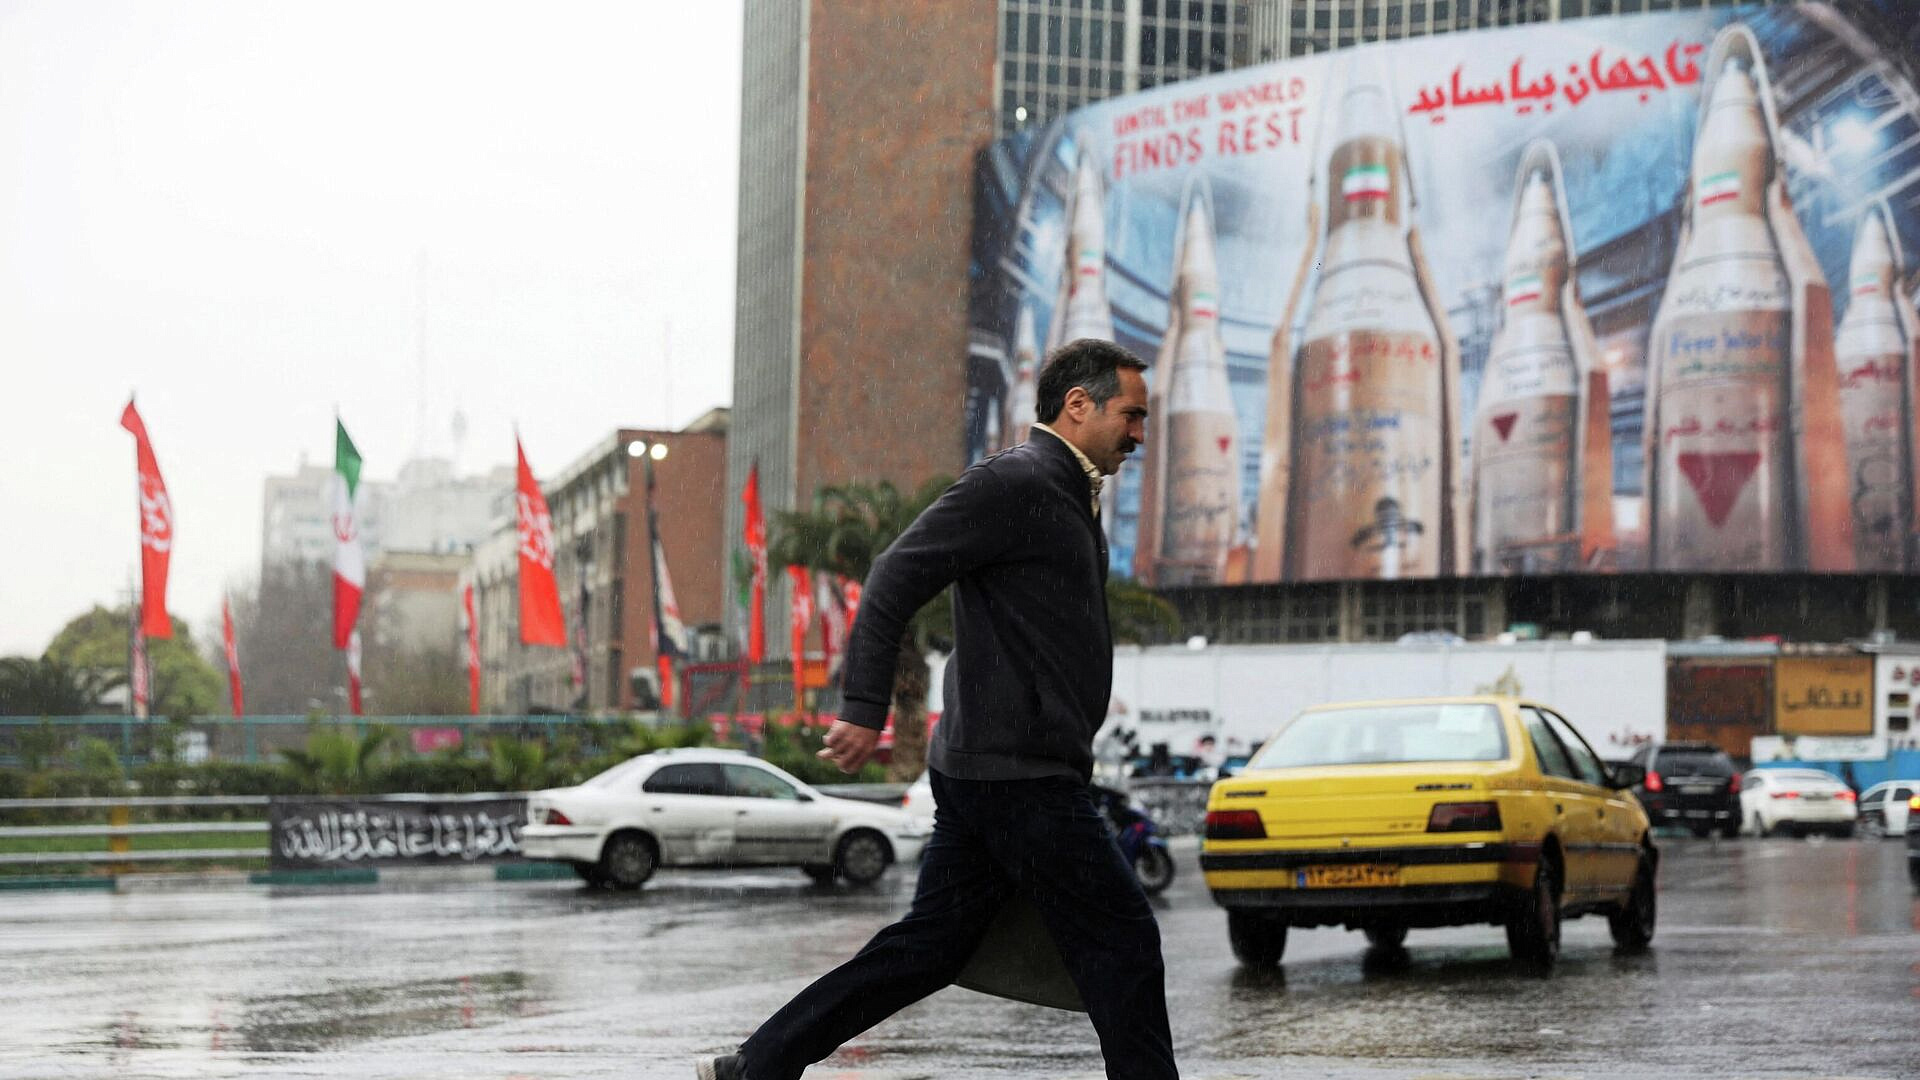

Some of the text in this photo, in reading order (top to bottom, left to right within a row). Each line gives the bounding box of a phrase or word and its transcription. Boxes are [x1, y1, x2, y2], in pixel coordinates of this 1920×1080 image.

[1114, 77, 1305, 136] UNTIL THE WORLD
[1408, 39, 1704, 124] تا جهان بیاساید
[1114, 106, 1305, 180] FINDS REST
